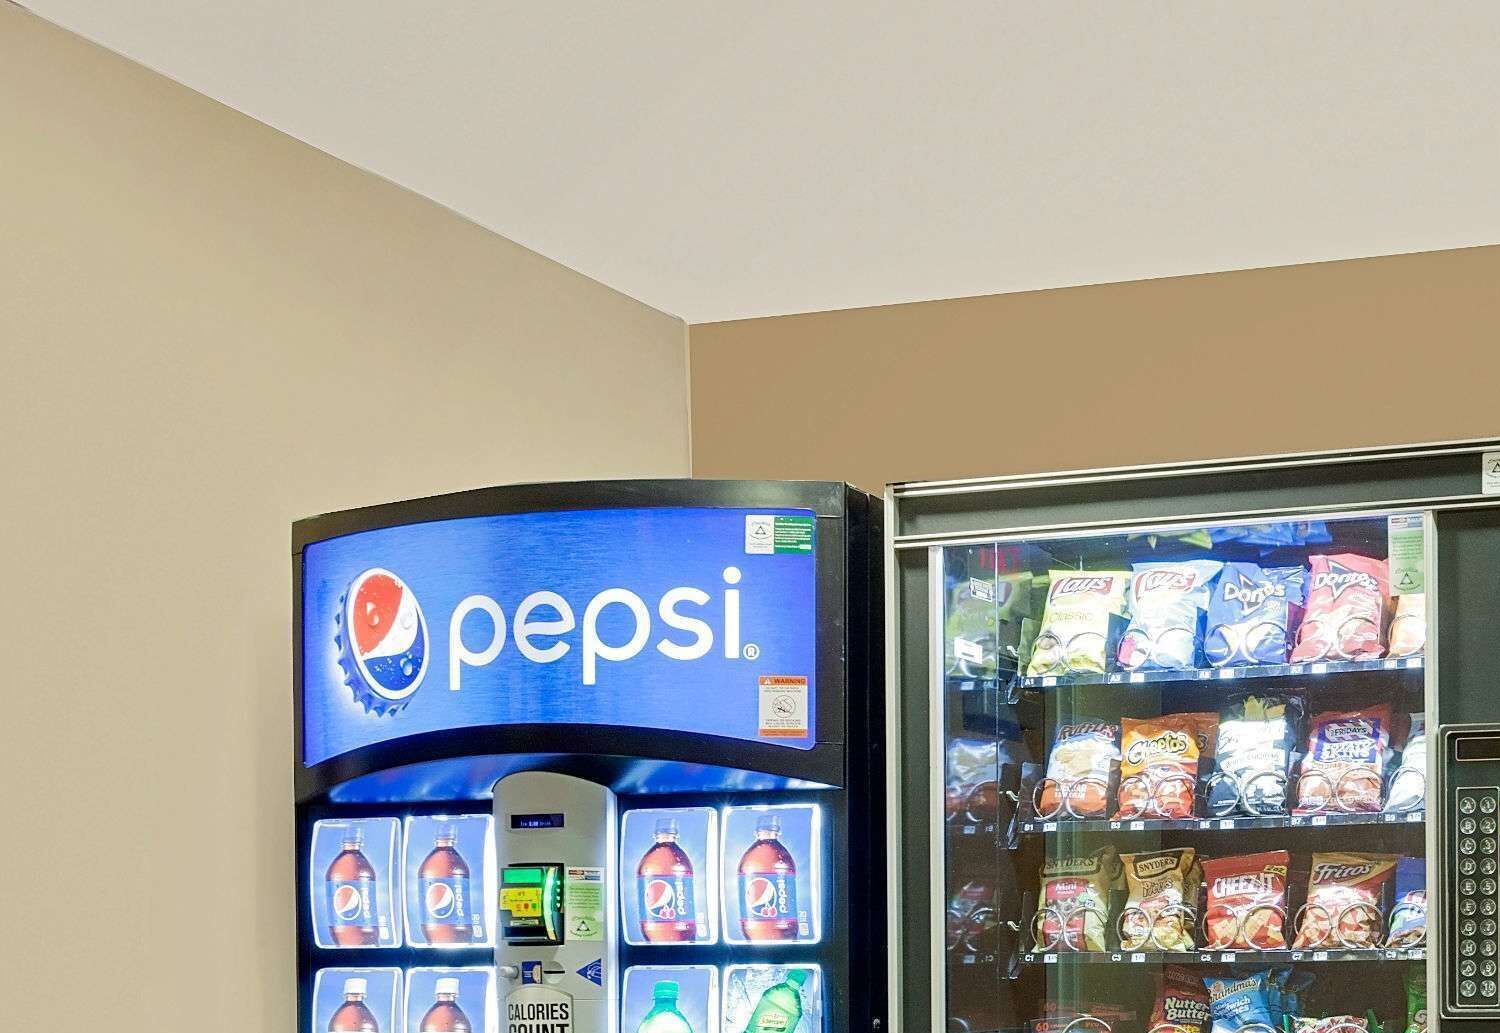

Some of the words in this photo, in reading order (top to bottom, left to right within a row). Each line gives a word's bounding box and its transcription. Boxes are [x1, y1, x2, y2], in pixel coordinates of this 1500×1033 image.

[449, 566, 740, 691] pepsi
[1312, 862, 1374, 885] Fritos
[1025, 954, 1034, 962] C1
[508, 1003, 569, 1021] CALORIES
[1164, 997, 1210, 1011] Nutter
[1165, 1008, 1212, 1022] Butter
